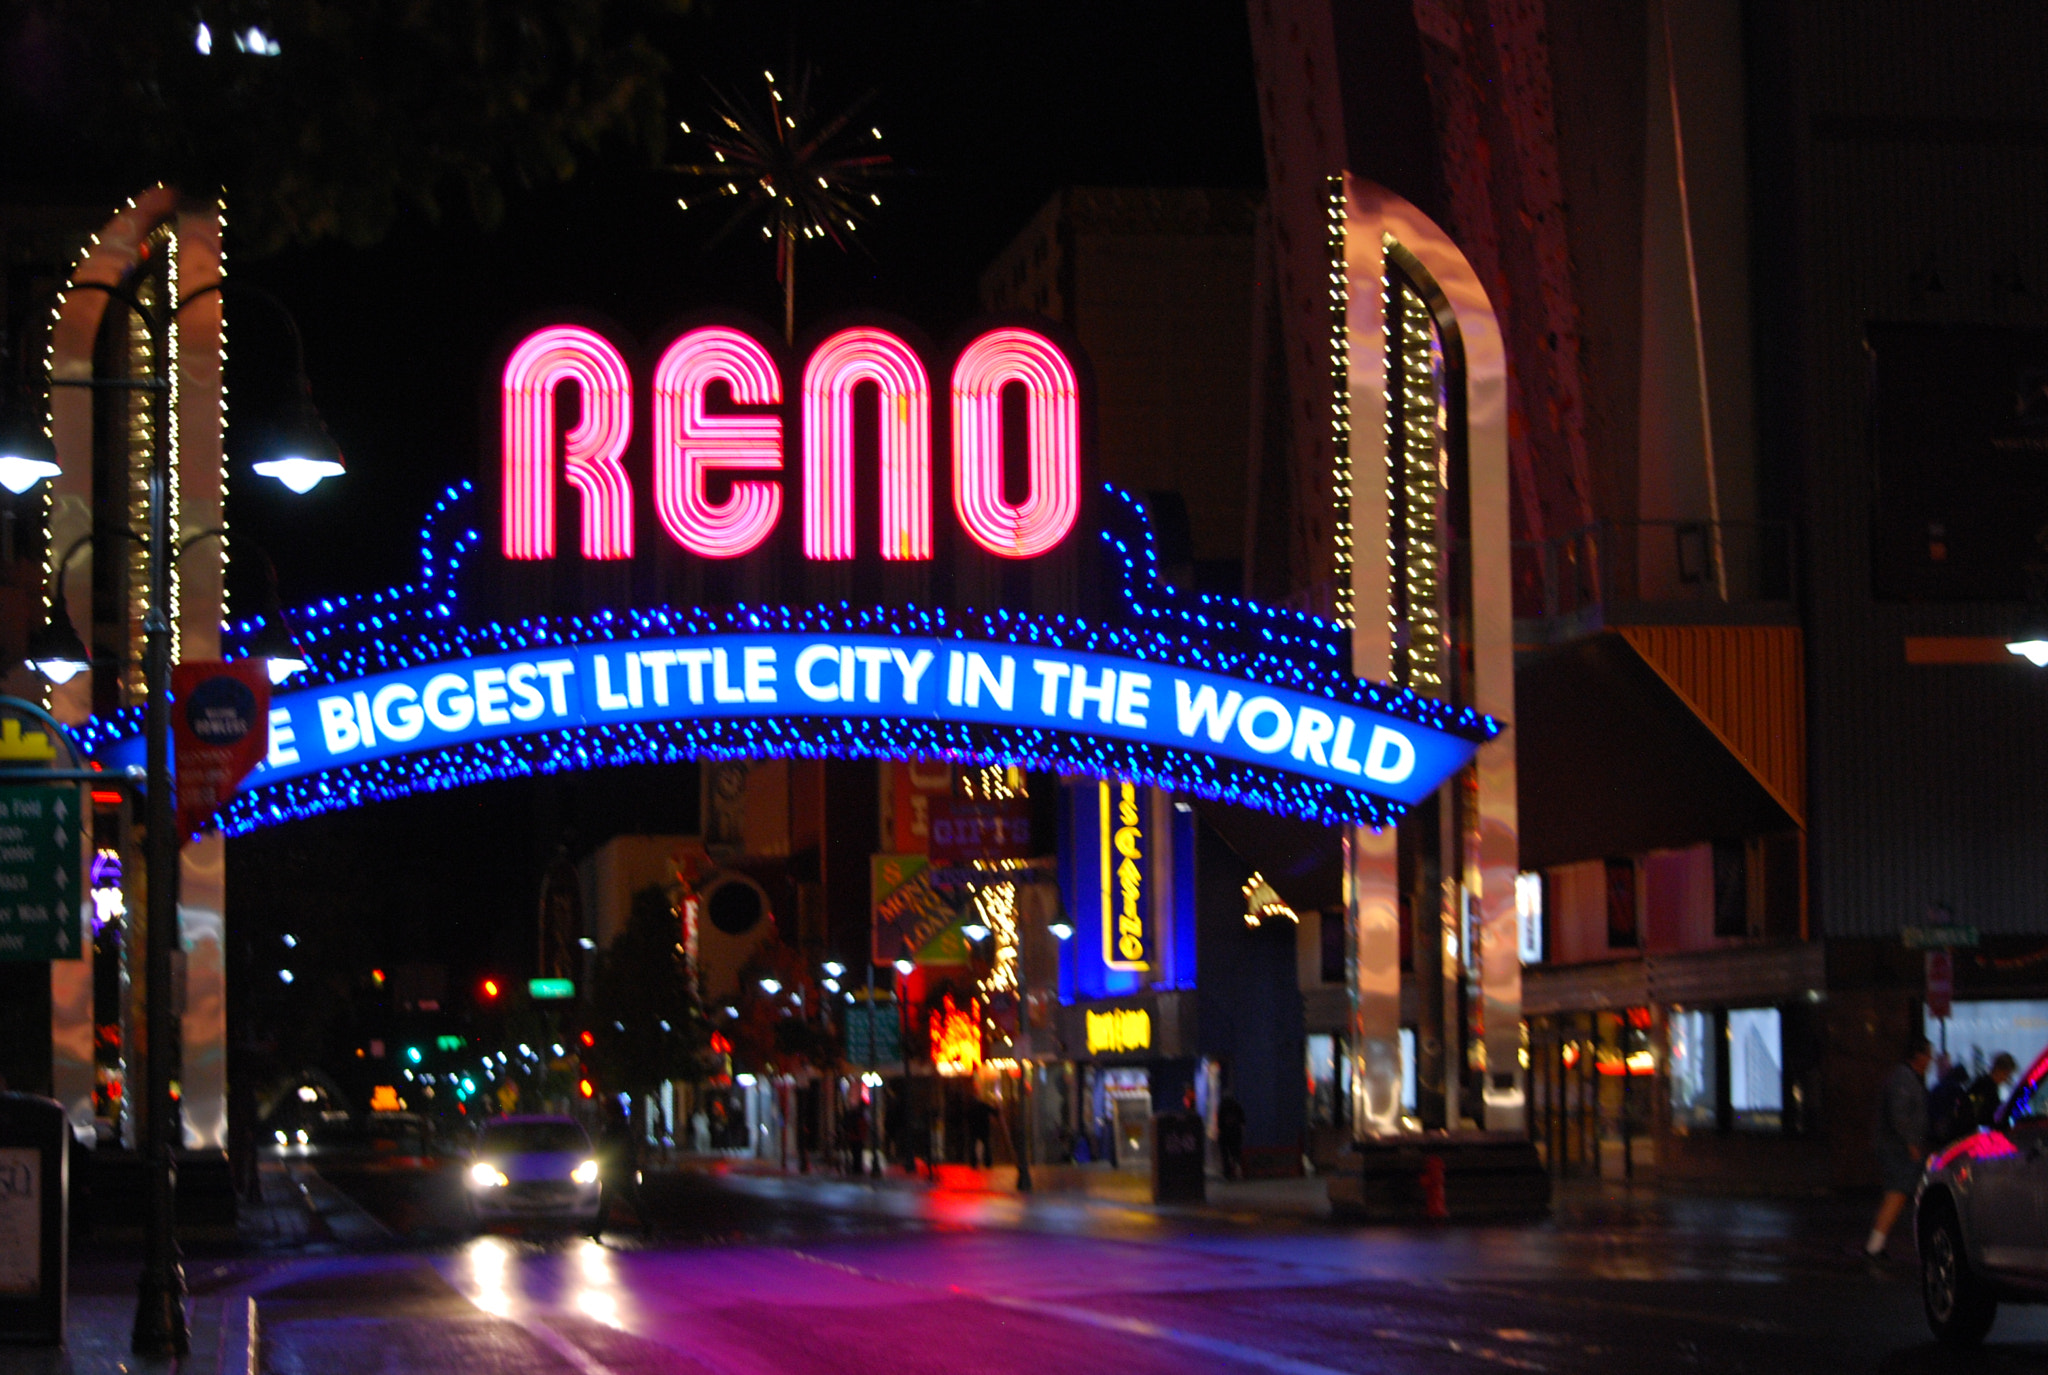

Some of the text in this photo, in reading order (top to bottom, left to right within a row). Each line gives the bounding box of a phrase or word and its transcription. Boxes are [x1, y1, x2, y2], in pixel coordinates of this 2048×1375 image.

[502, 324, 1081, 561] RENO
[318, 659, 574, 755] BIGGEST
[594, 647, 777, 711] LITTLE
[795, 644, 933, 703] CITY
[947, 651, 1016, 711] IN
[1033, 659, 1151, 729] THE
[1175, 679, 1416, 784] WORLD
[1113, 826, 1143, 961] CASINO
